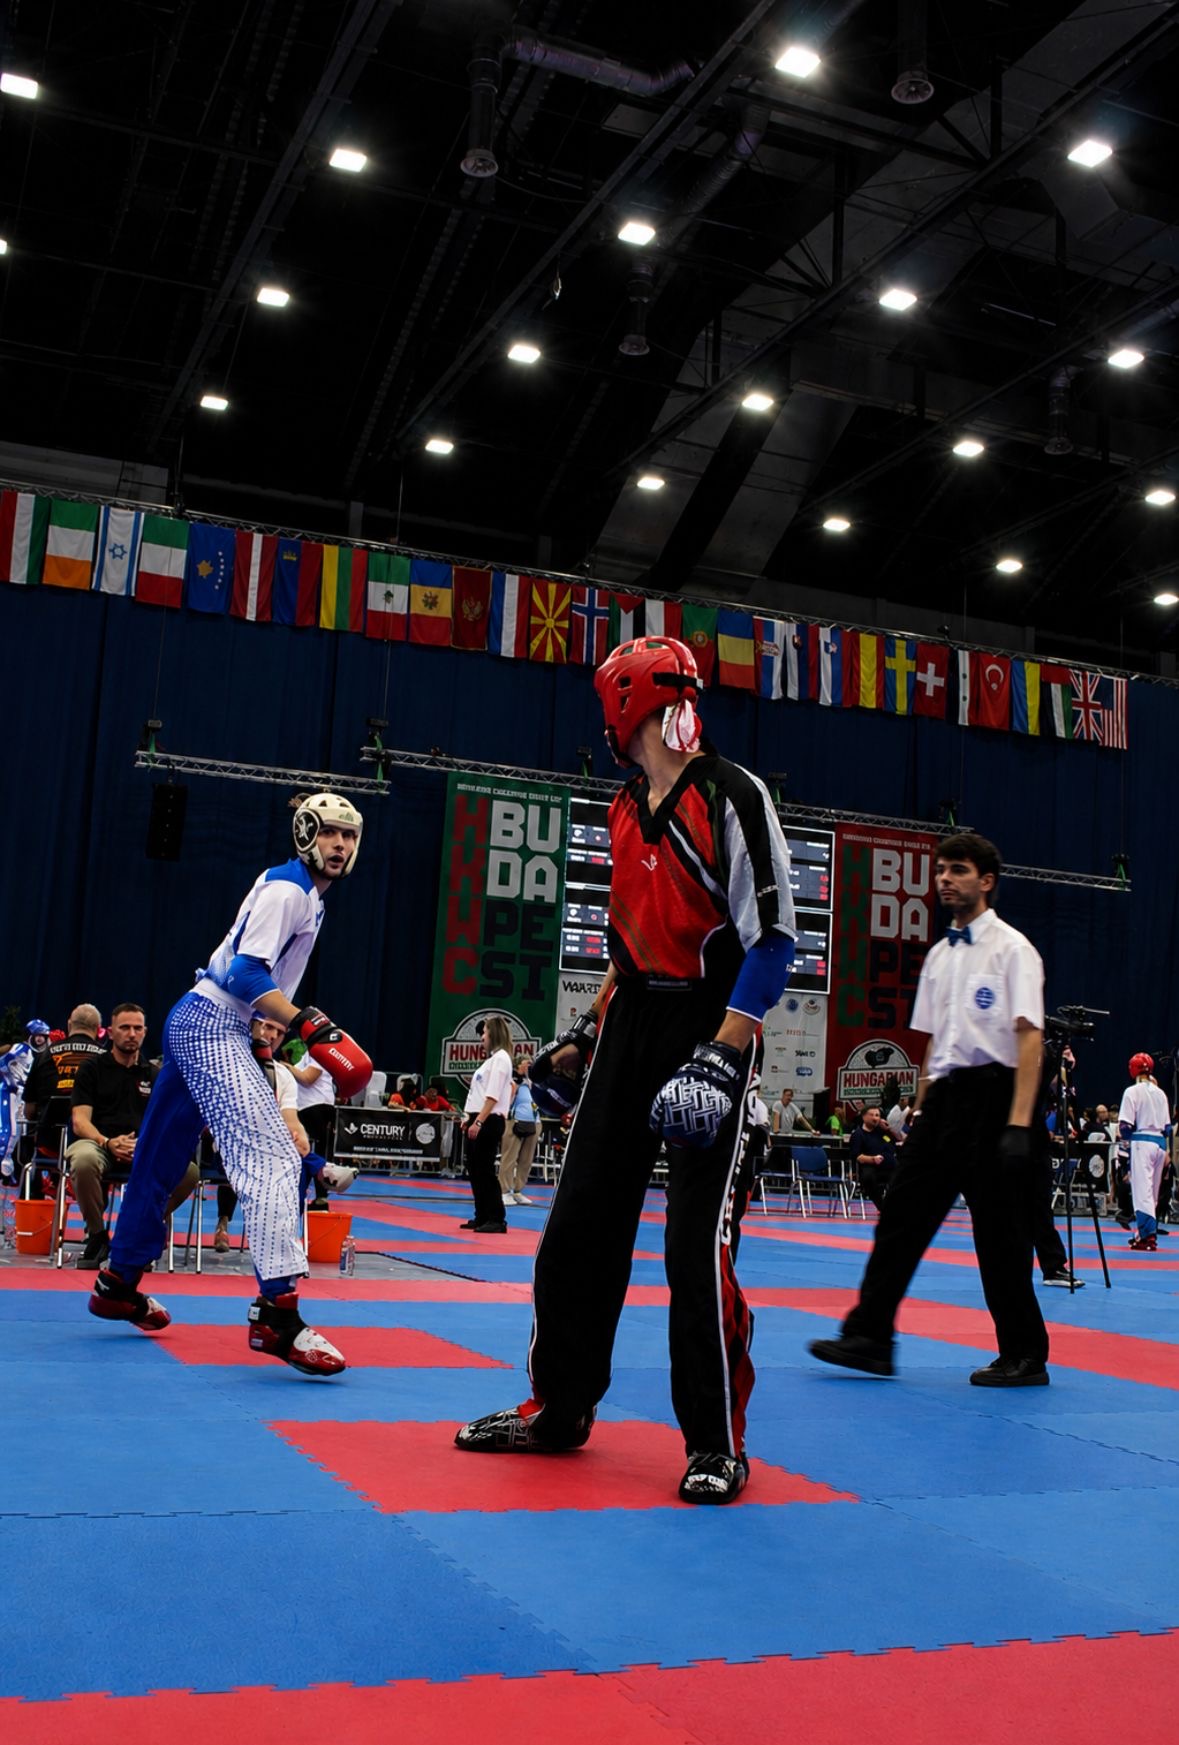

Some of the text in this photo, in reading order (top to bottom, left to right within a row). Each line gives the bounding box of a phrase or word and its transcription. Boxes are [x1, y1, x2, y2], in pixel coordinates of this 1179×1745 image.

[490, 800, 562, 854] BU
[486, 849, 559, 904] DA
[872, 848, 930, 896] BU
[483, 900, 557, 951] PE
[870, 893, 929, 942] DA
[360, 1123, 405, 1137] CENTURY
